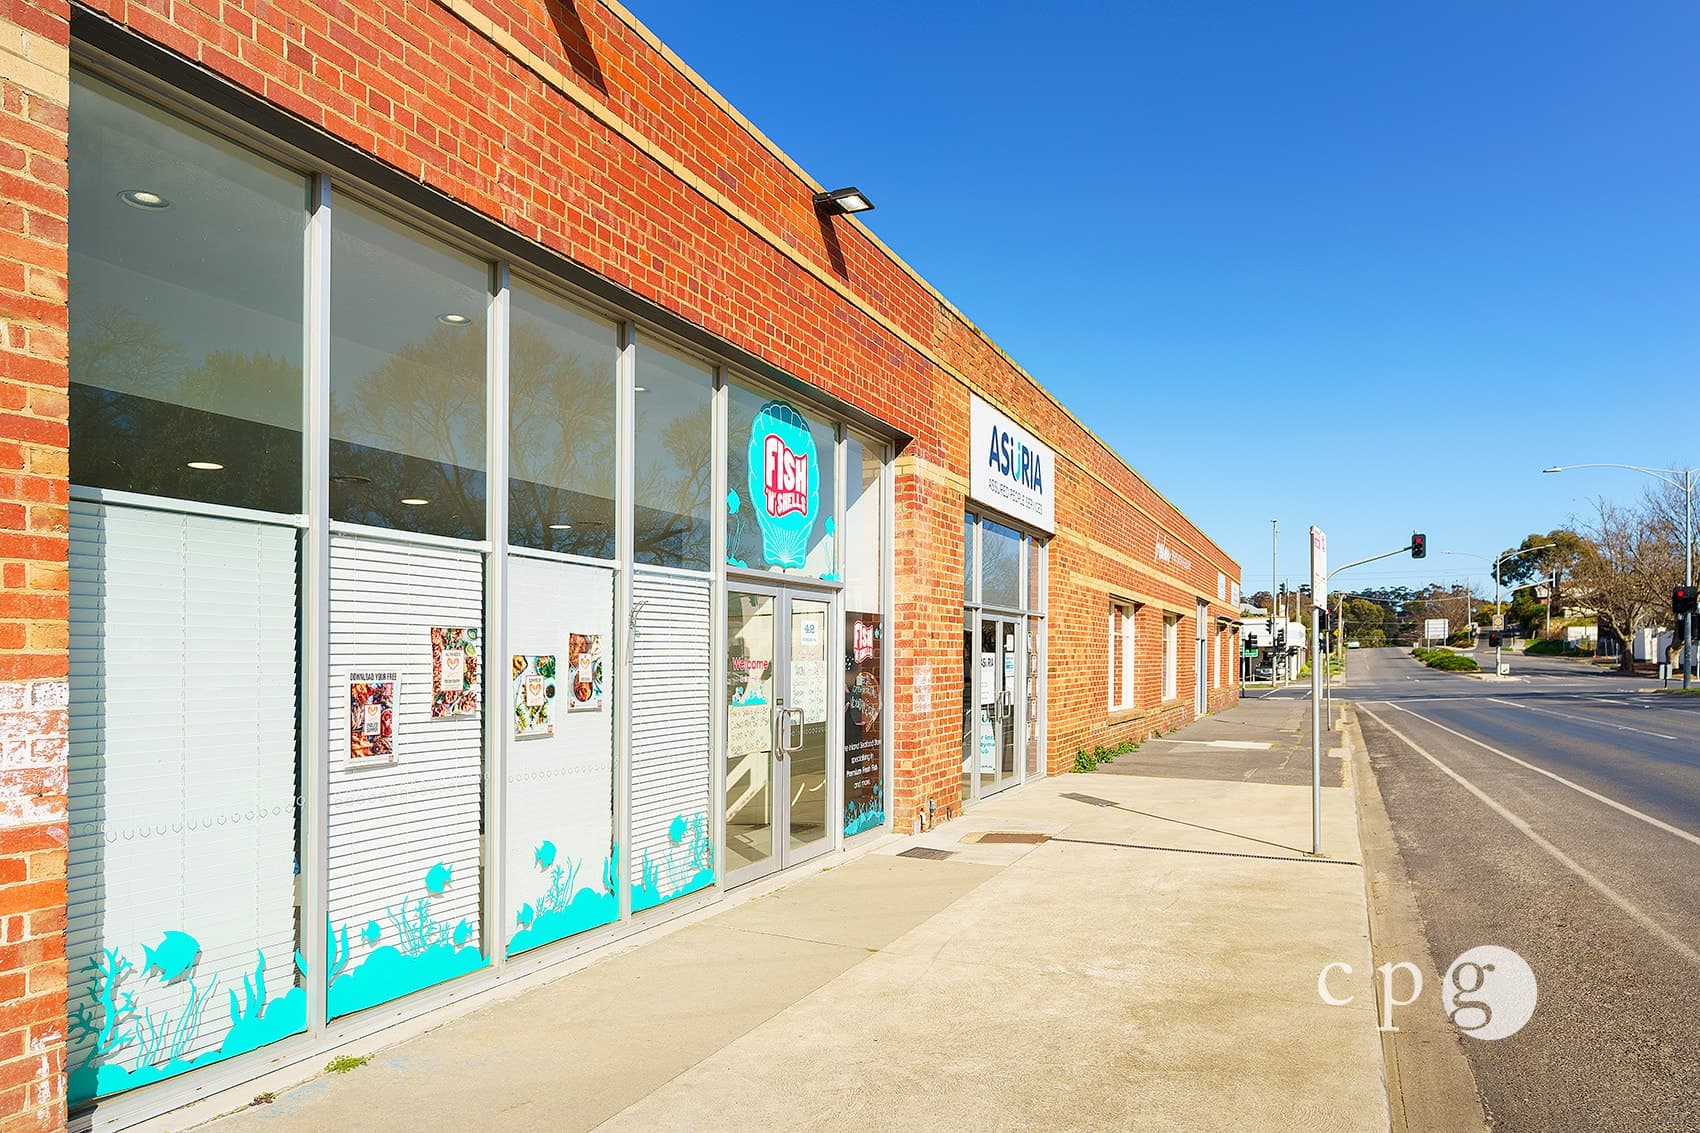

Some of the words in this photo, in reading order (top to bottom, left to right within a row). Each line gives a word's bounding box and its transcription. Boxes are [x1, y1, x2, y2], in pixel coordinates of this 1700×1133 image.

[765, 436, 808, 495] FISH
[989, 425, 1043, 495] ASURIA
[777, 491, 808, 515] SHELLS
[732, 657, 769, 671] Welcome
[350, 672, 375, 681] DOWNLOAD
[375, 672, 386, 681] YOUR
[387, 672, 397, 681] FREE
